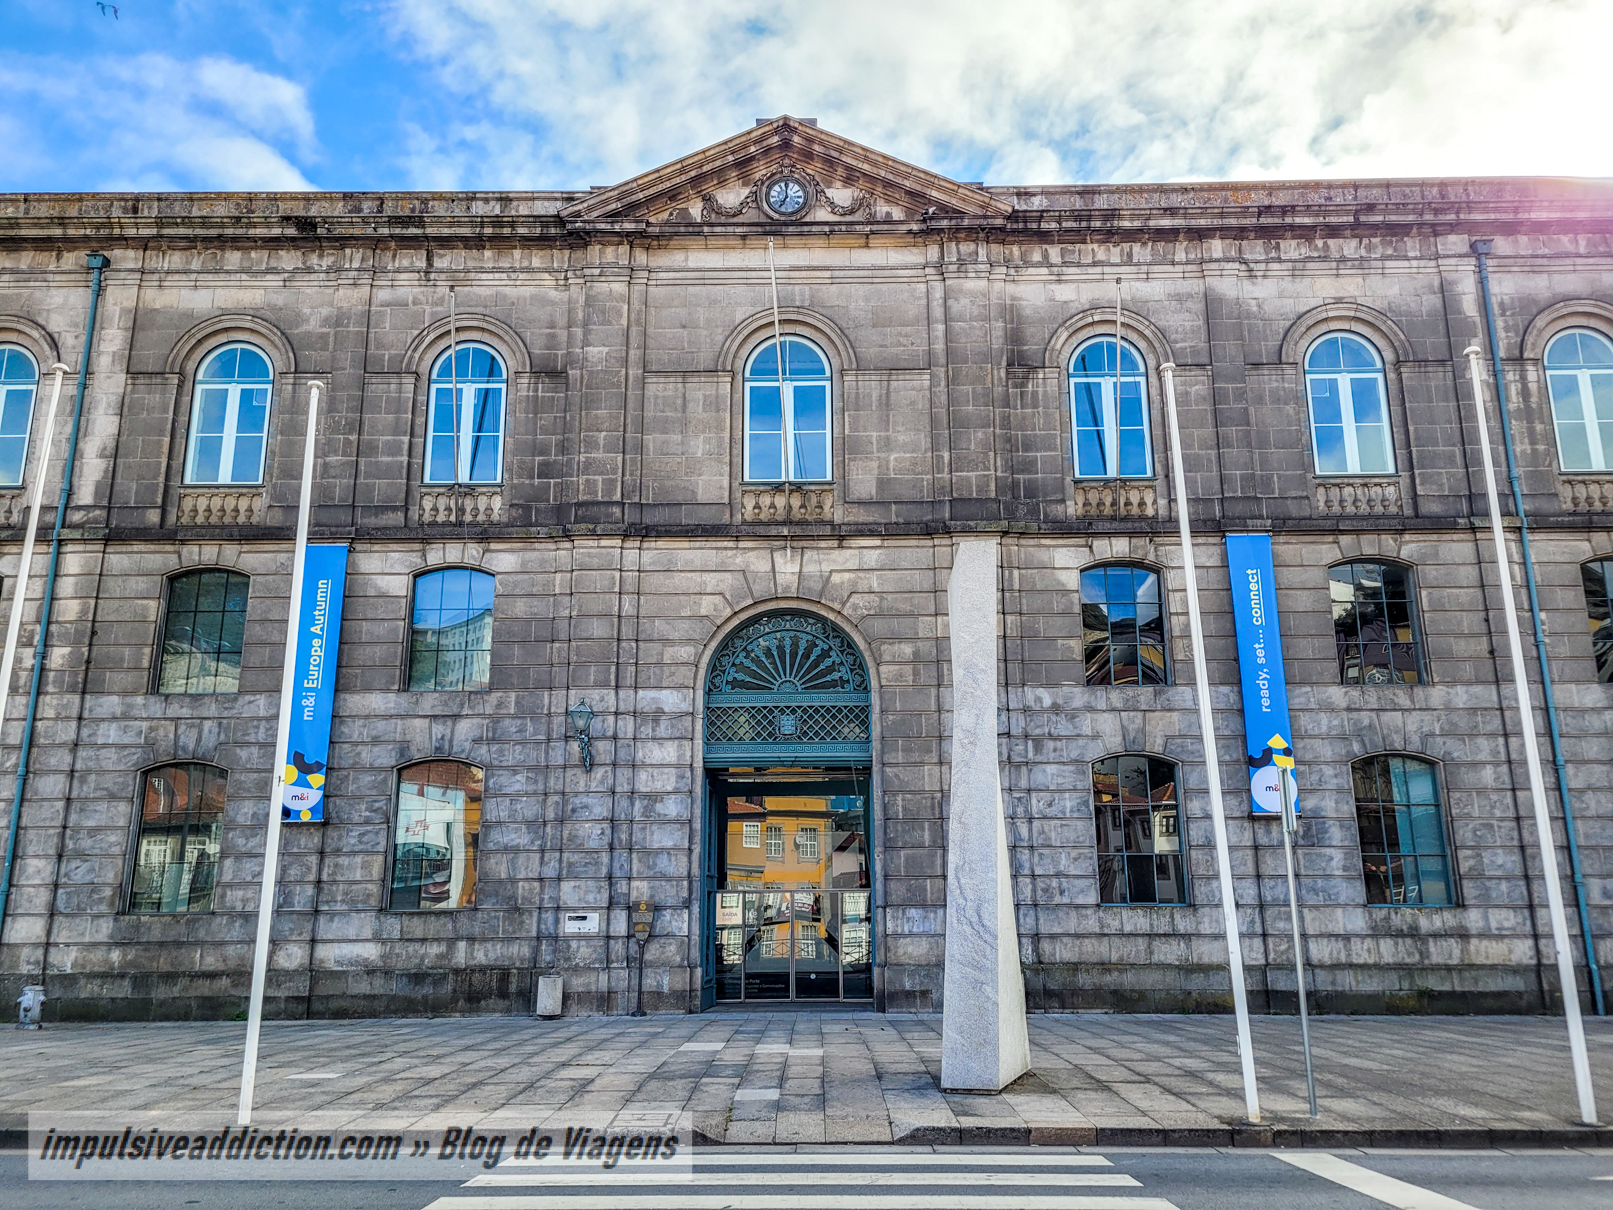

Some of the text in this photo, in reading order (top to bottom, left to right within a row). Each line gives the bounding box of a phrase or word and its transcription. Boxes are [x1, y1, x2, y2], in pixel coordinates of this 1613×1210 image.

[301, 579, 328, 720] m&i Europe Autumn
[1246, 568, 1271, 712] ready, set... connect
[291, 792, 309, 801] m&i
[1265, 783, 1280, 792] m&
